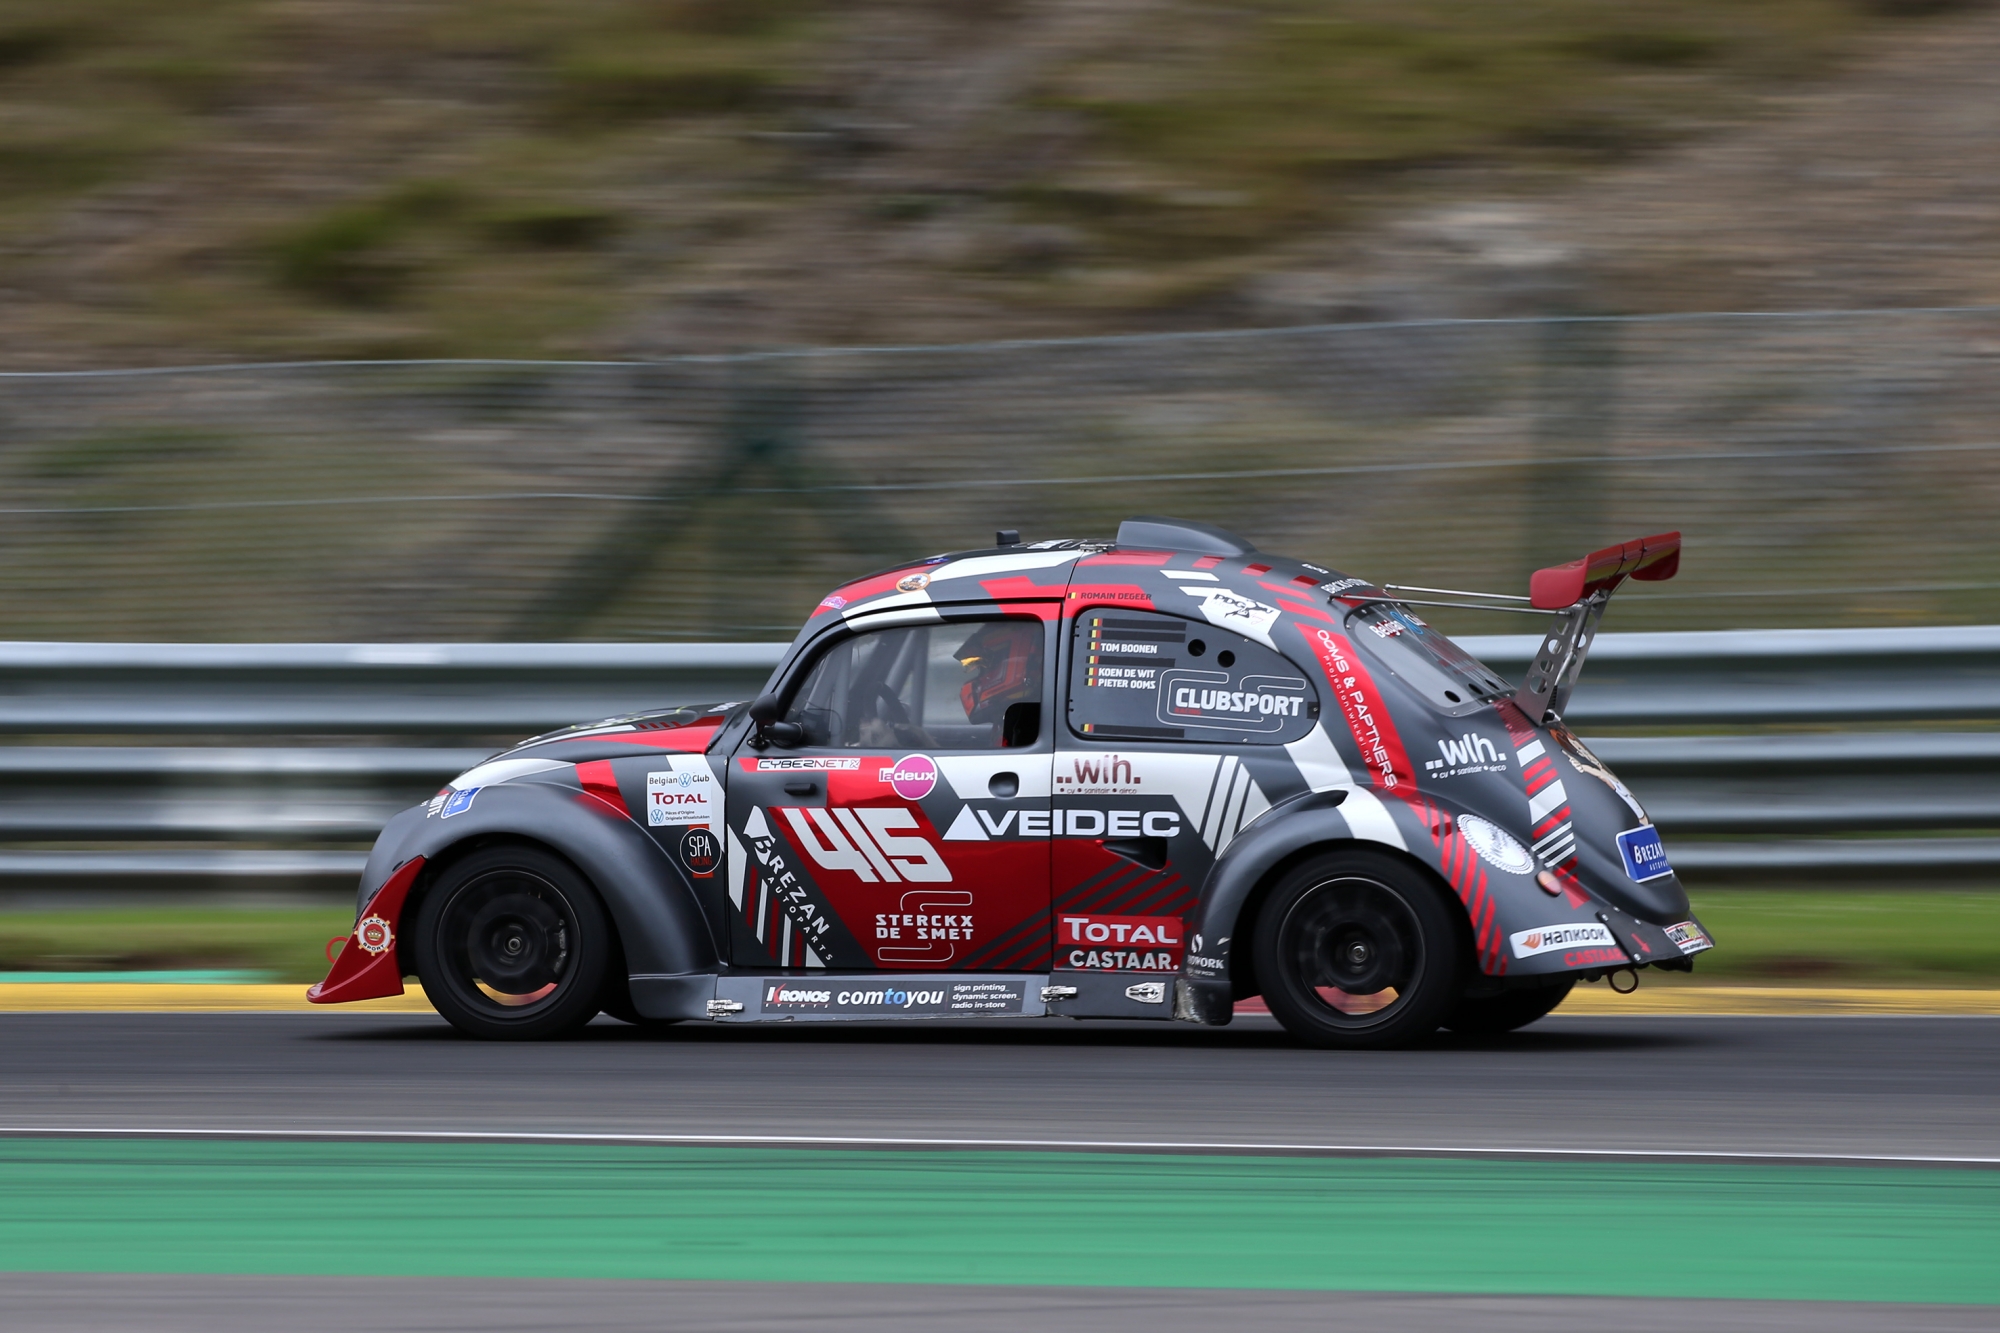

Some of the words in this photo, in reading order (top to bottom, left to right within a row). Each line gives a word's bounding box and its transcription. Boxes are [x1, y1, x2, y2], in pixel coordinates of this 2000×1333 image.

[1081, 592, 1116, 600] ROMAIN
[1101, 643, 1119, 652] TOM
[1121, 644, 1157, 654] BOONEN
[1317, 629, 1350, 673] OOMS
[1343, 676, 1356, 689] &
[1098, 668, 1123, 677] KOEN
[1124, 669, 1135, 678] DE
[1137, 670, 1155, 678] WIT
[1098, 679, 1128, 688] PIETER
[1130, 680, 1156, 689] OOMS
[1175, 688, 1303, 717] CLUBSPORT
[759, 760, 848, 769] CYBERNET
[649, 777, 678, 786] Belgian
[692, 774, 710, 783] Club
[652, 792, 707, 805] TOTAL
[688, 836, 712, 857] SPA
[781, 808, 953, 883] 415
[1634, 842, 1665, 864] BREZAN
[690, 856, 713, 867] RACING
[753, 837, 831, 936] BREZAN
[767, 876, 834, 962] AUTOPARTS
[876, 914, 974, 927] STERCKX
[876, 927, 901, 939] DE
[917, 928, 974, 940] SMET
[1063, 918, 1178, 944] TOTAL
[362, 942, 385, 951] SPORT
[766, 983, 832, 1003] KRONOS
[953, 984, 971, 992] sign
[837, 988, 944, 1009] comtoyou
[952, 993, 988, 1001] dynamic
